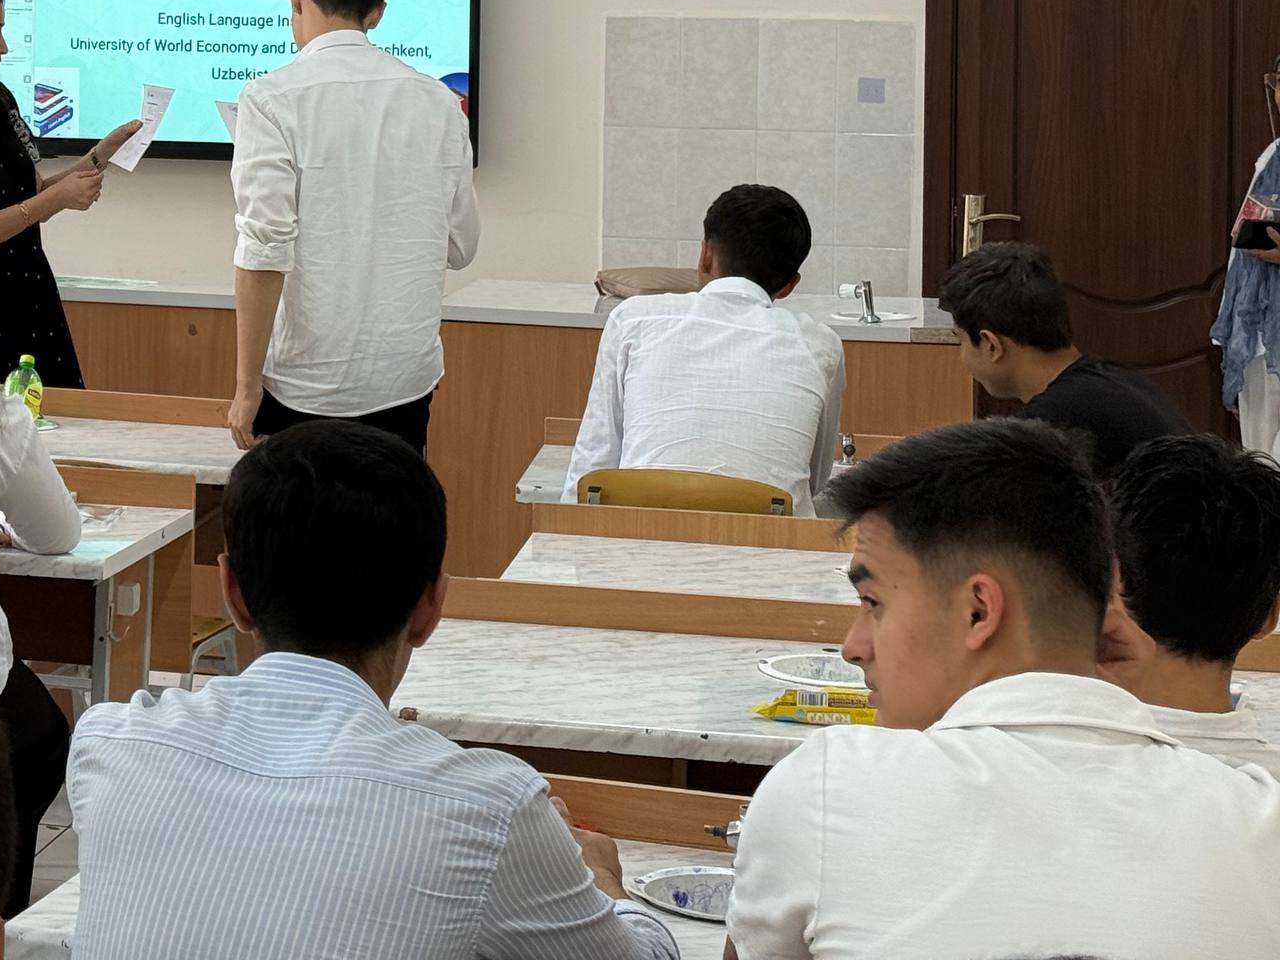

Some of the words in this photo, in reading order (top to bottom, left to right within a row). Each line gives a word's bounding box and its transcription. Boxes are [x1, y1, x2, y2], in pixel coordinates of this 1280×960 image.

[158, 12, 206, 28] English
[209, 13, 274, 29] Language
[278, 14, 293, 27] In
[70, 37, 134, 54] University
[137, 38, 151, 52] of
[154, 39, 193, 53] World
[197, 40, 258, 56] Economy
[262, 41, 286, 54] and
